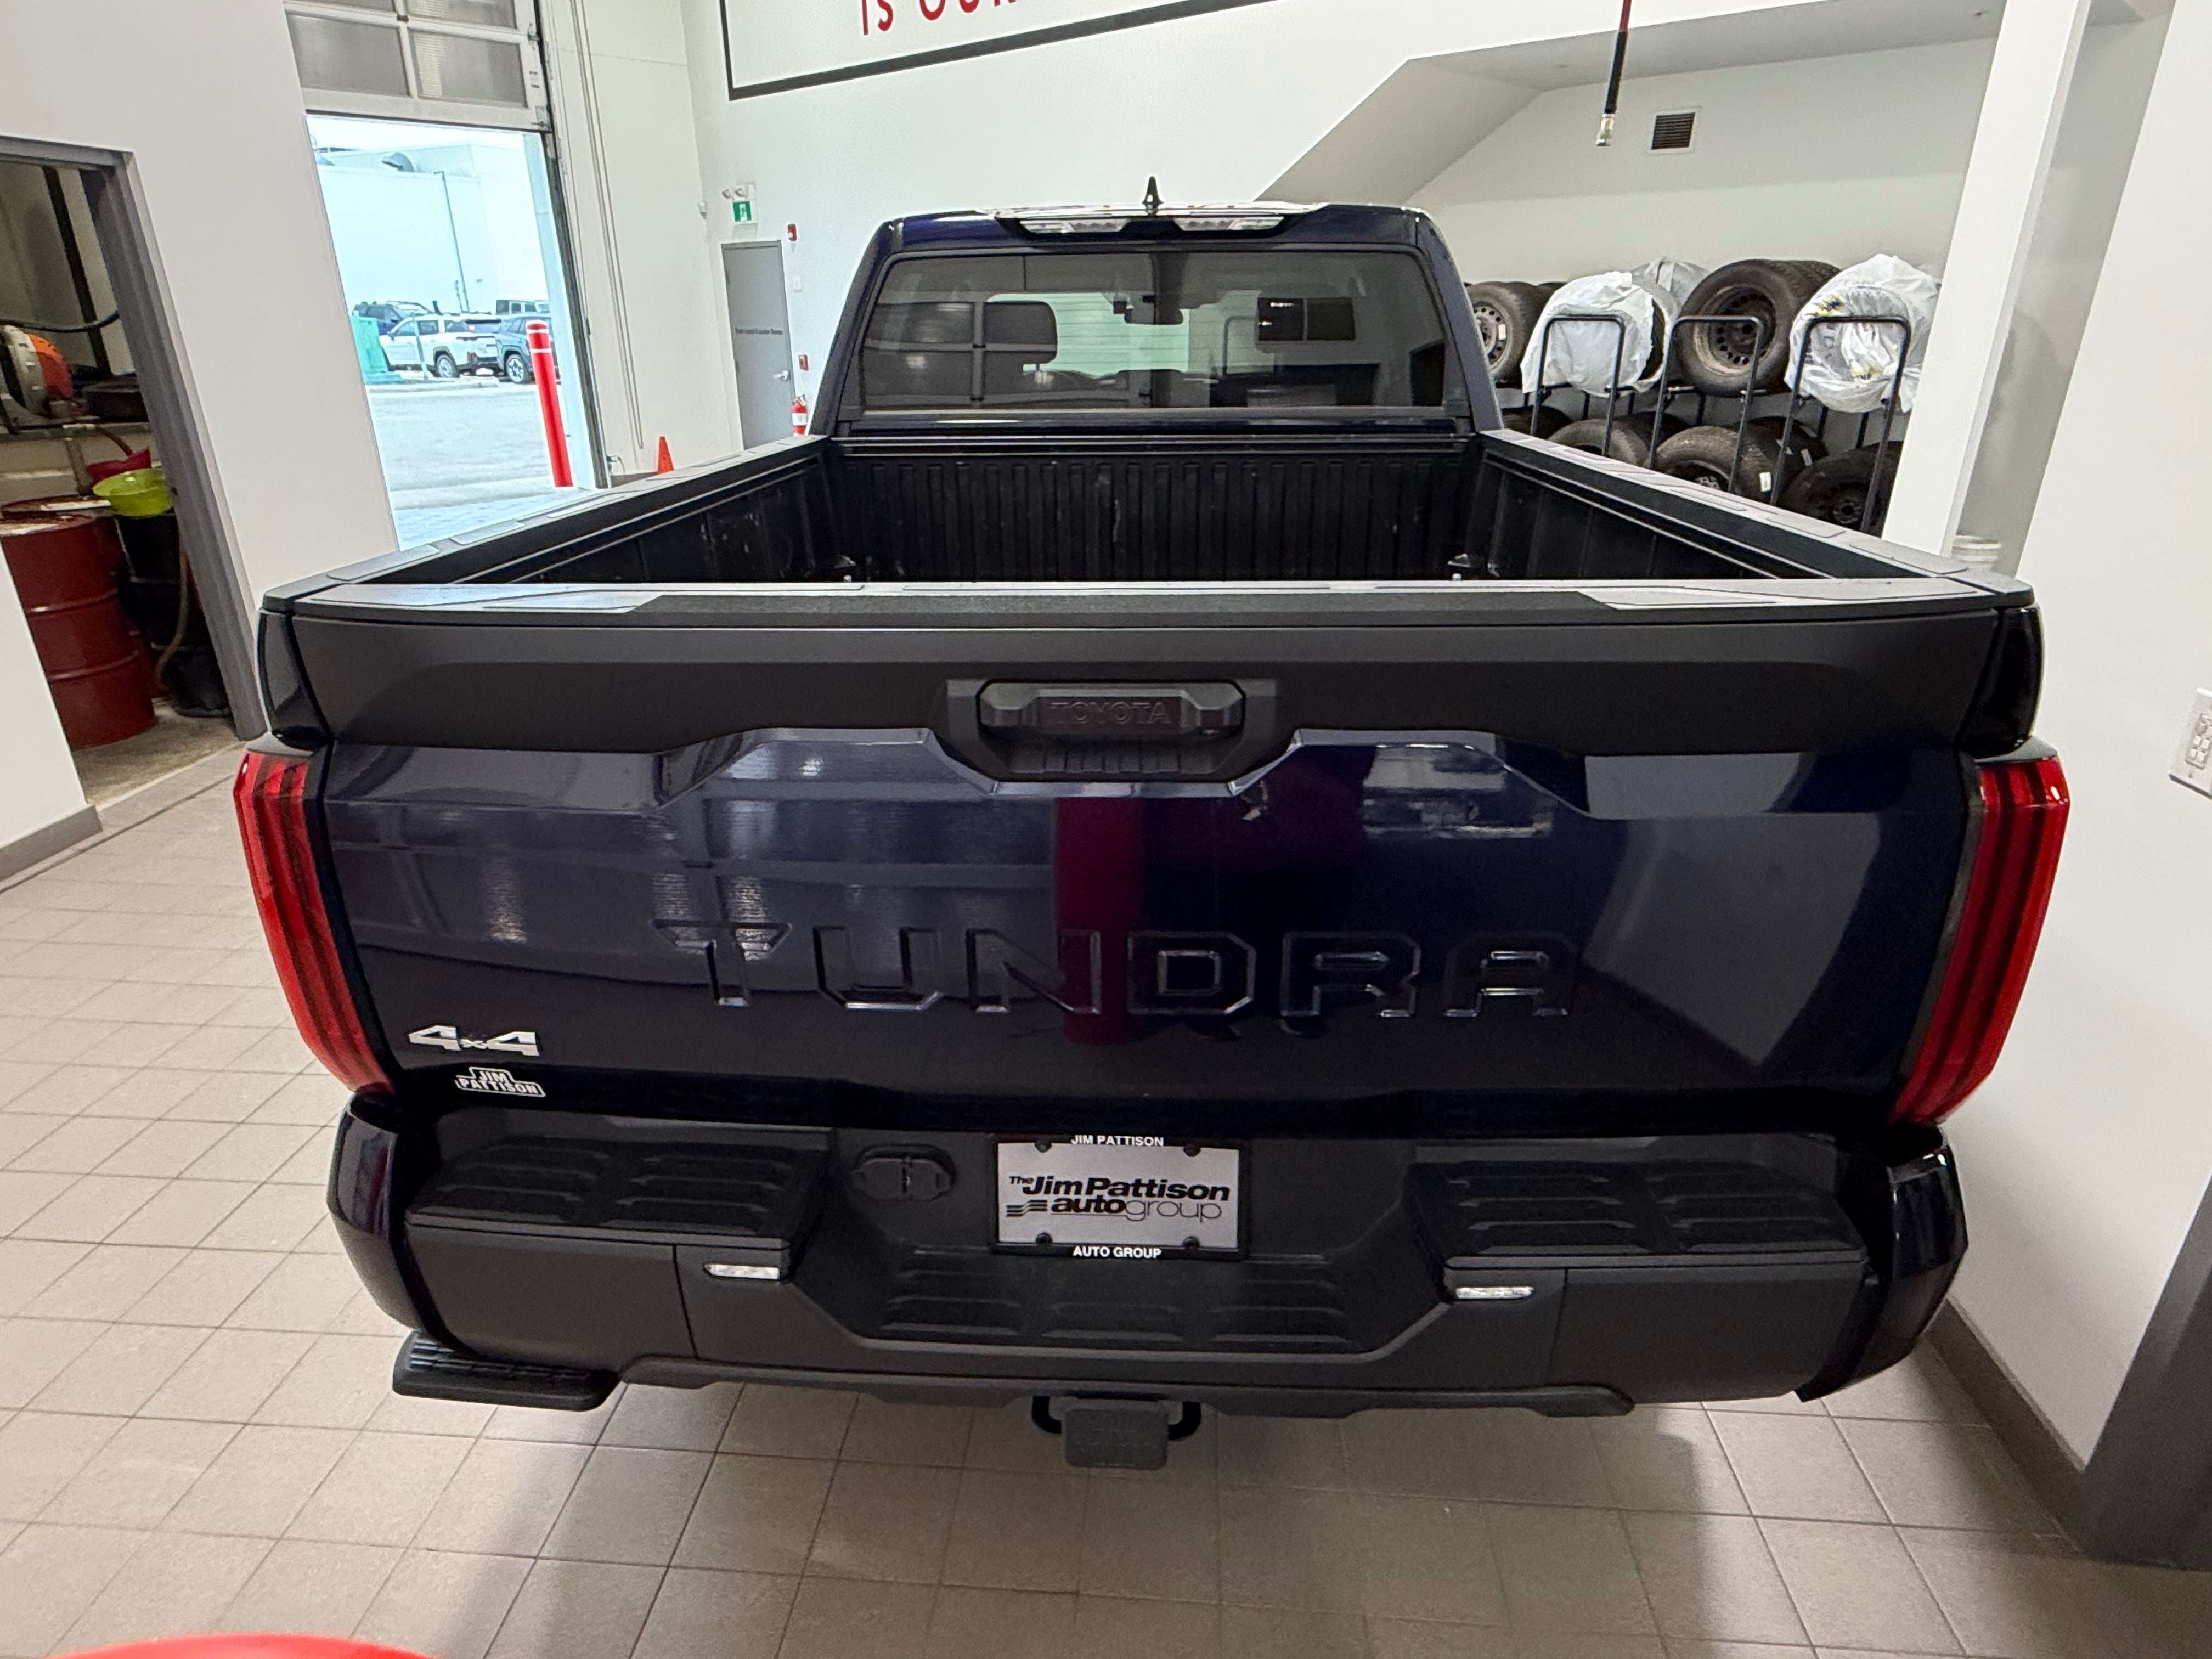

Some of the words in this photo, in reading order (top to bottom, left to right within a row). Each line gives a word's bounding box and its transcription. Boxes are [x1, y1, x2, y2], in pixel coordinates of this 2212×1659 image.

[1049, 701, 1172, 724] TOYOTA
[650, 921, 1576, 1017] TUNDRA
[478, 1071, 507, 1082] JIM
[458, 1078, 539, 1094] PATTISON
[1071, 1135, 1094, 1146] JIM
[1097, 1135, 1164, 1147] PATTISON
[1008, 1176, 1035, 1185] The
[1073, 1246, 1111, 1258] AUTO
[1113, 1247, 1162, 1259] GROUP
